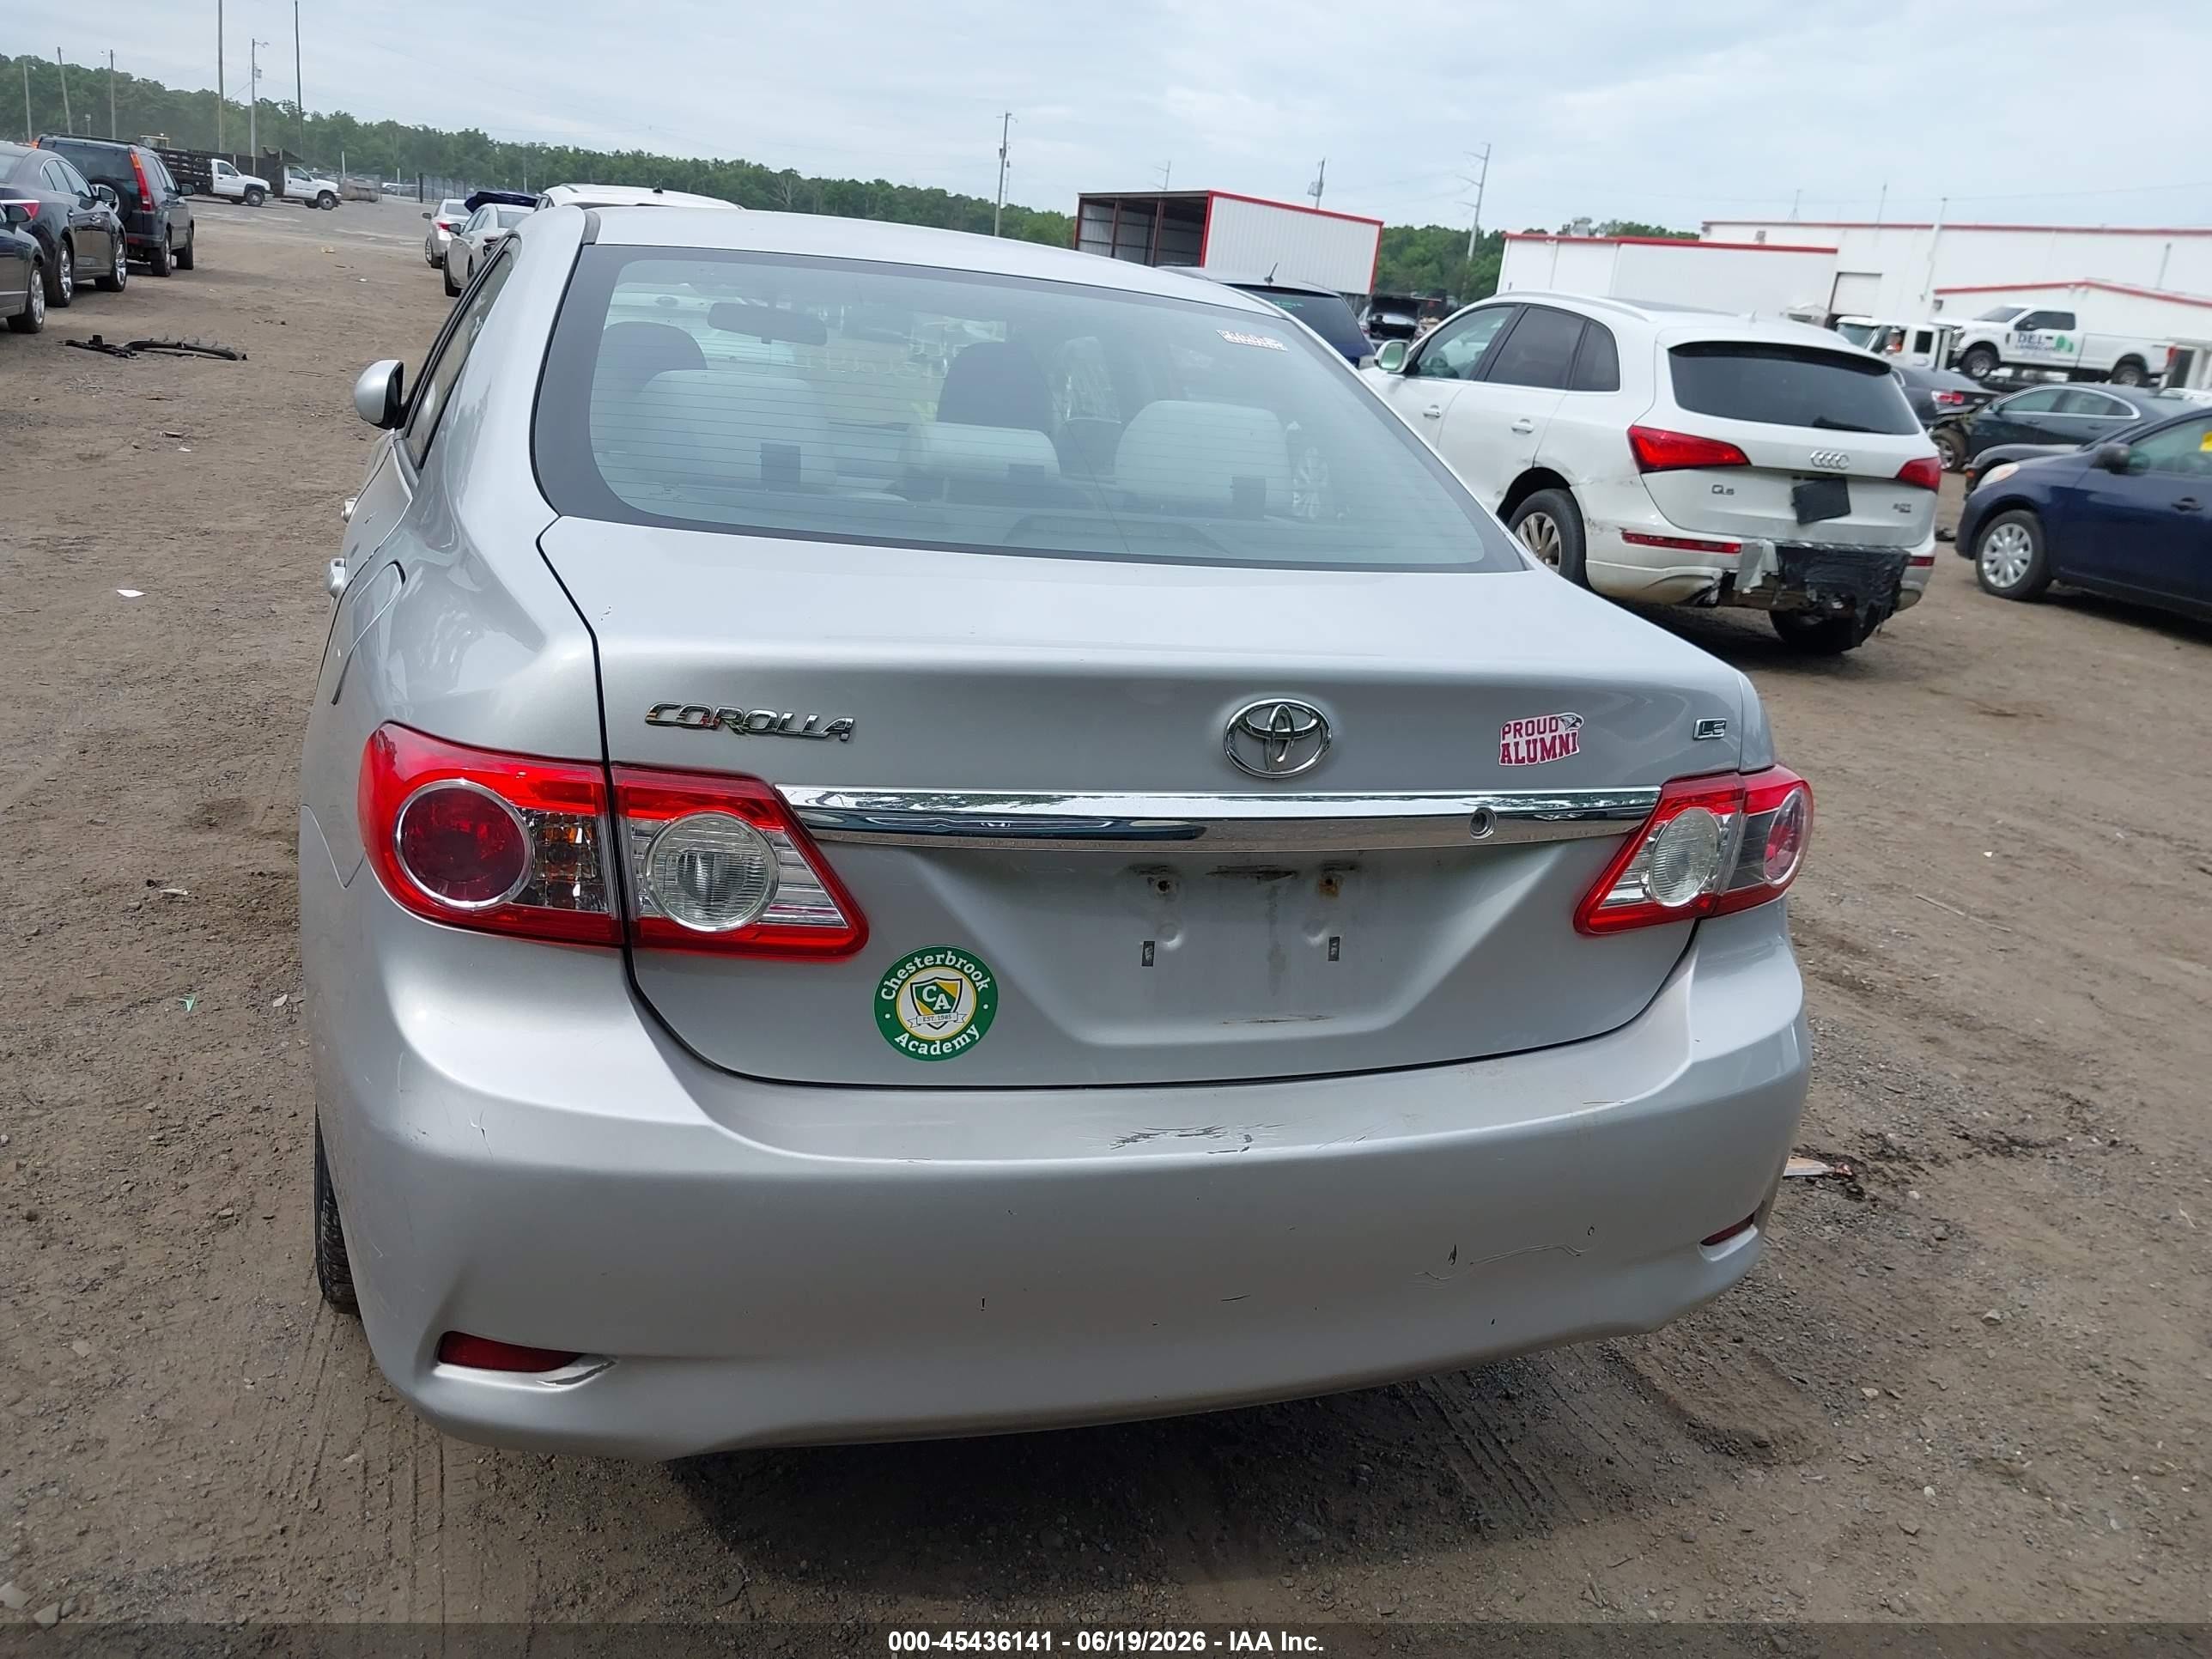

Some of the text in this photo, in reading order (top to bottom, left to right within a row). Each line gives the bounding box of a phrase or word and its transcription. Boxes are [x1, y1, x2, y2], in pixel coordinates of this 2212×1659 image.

[1711, 484, 1735, 495] Q5
[645, 702, 854, 741] COROLLA
[1502, 716, 1559, 740] PROUD
[1698, 720, 1726, 738] LE
[1500, 732, 1577, 764] ALUMNI
[881, 951, 991, 1000] Chesterbrook
[922, 986, 951, 1011] CA
[895, 1024, 980, 1055] Academy
